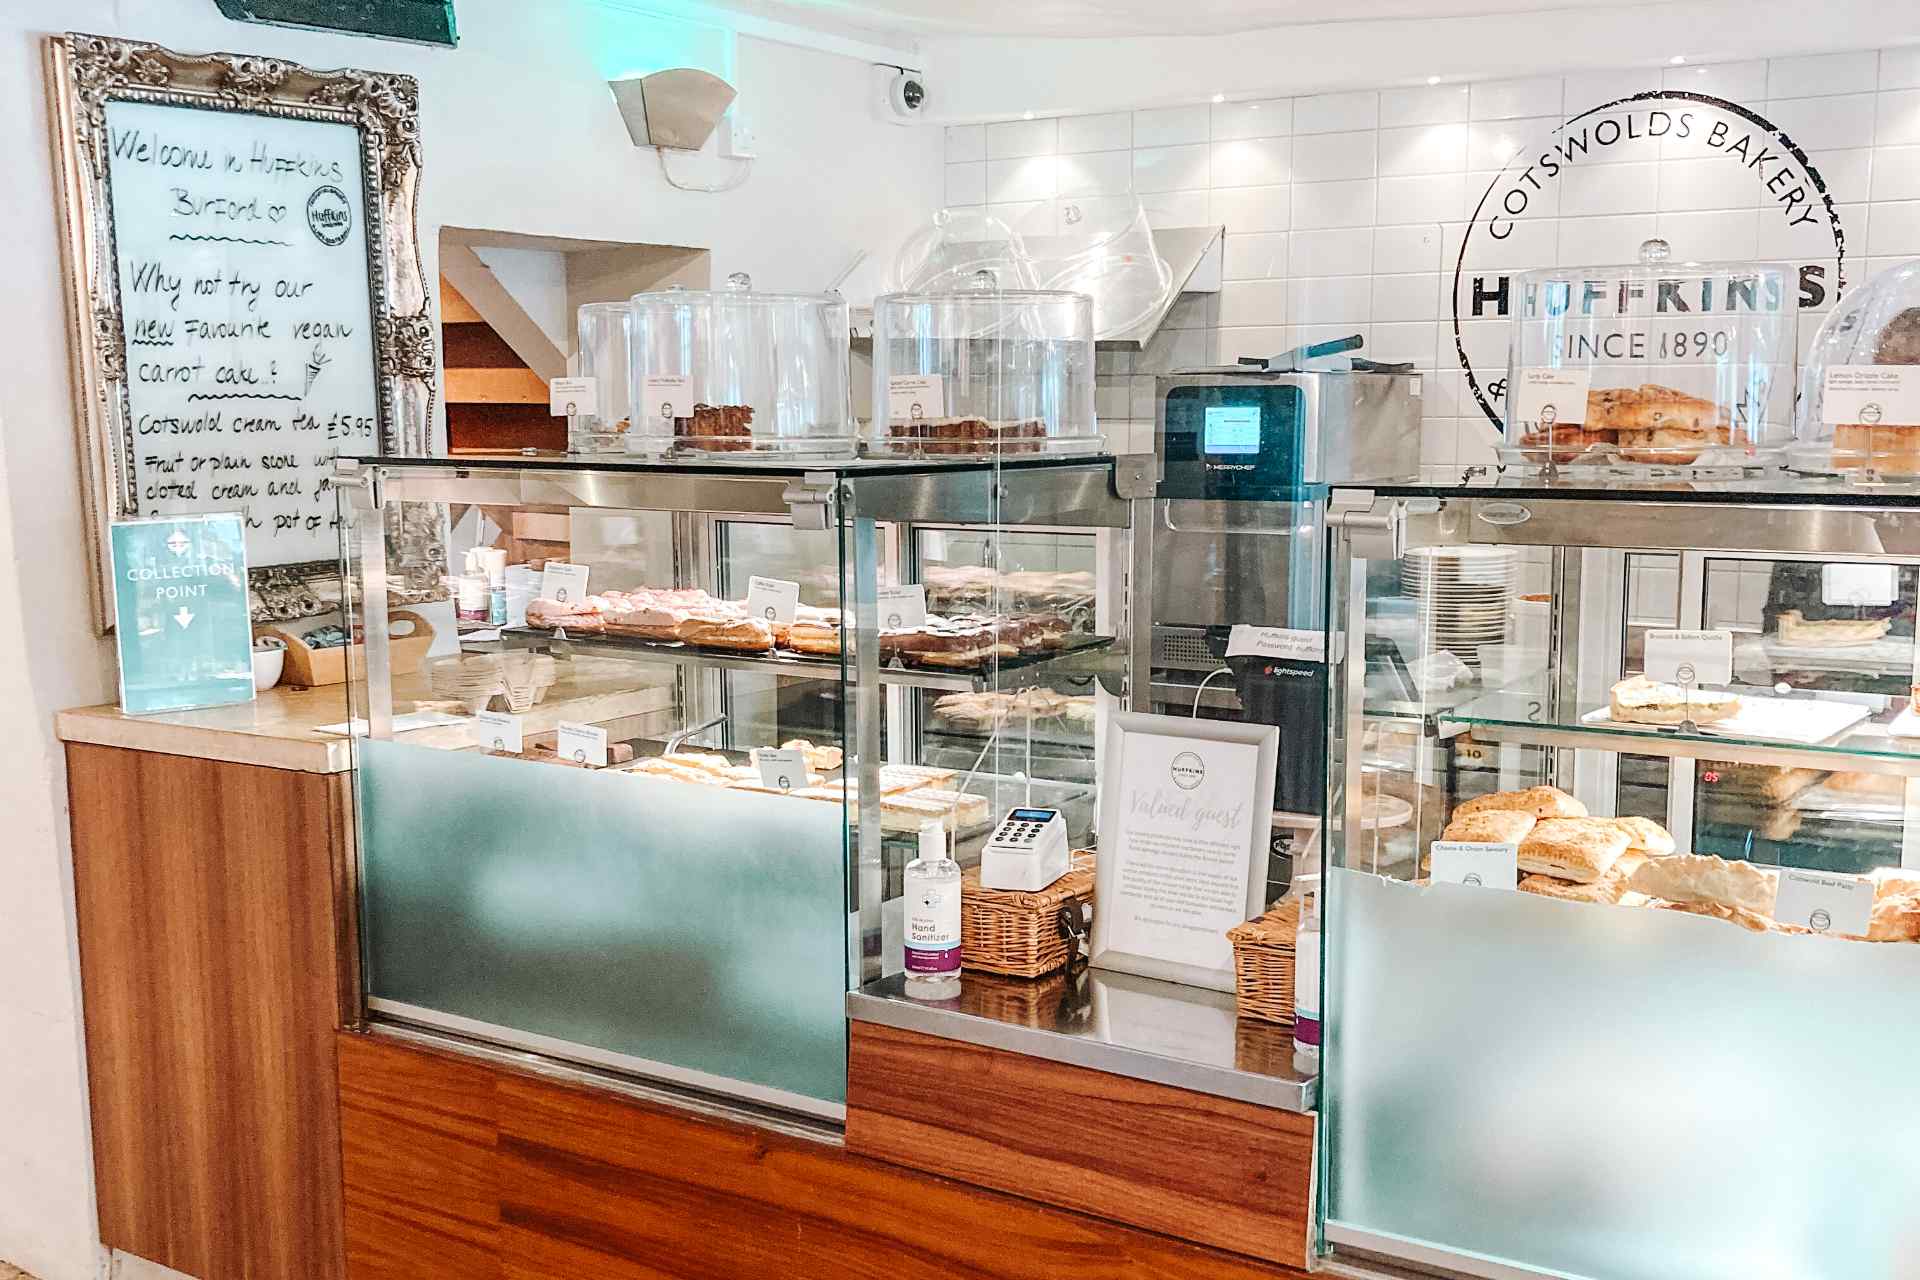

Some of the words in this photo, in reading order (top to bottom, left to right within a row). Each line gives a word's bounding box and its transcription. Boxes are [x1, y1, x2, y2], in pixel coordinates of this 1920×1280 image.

[111, 127, 213, 169] Welcome
[1489, 111, 1694, 239] COTSWOLDS
[1707, 120, 1819, 227] BAKERY
[130, 260, 182, 311] Why
[194, 268, 222, 296] not
[228, 271, 261, 312] try
[275, 279, 313, 298] our
[1472, 265, 1825, 316] HUFFKINS
[134, 319, 174, 338] new
[292, 319, 353, 341] vegan
[139, 355, 205, 383] carrot
[139, 409, 224, 436] Cotswold
[233, 415, 281, 434] cream
[292, 406, 320, 431] tea
[191, 456, 207, 473] or
[209, 451, 250, 478] plain
[211, 480, 258, 500] cream
[267, 479, 302, 496] and
[273, 510, 300, 538] pot
[127, 562, 235, 582] COLLECTION
[155, 583, 209, 601] POINT
[1273, 665, 1315, 678] lightspeed
[1130, 789, 1193, 821] Valued
[1191, 800, 1244, 832] guest
[911, 932, 951, 941] Sanitizer
[912, 922, 936, 932] Hand
